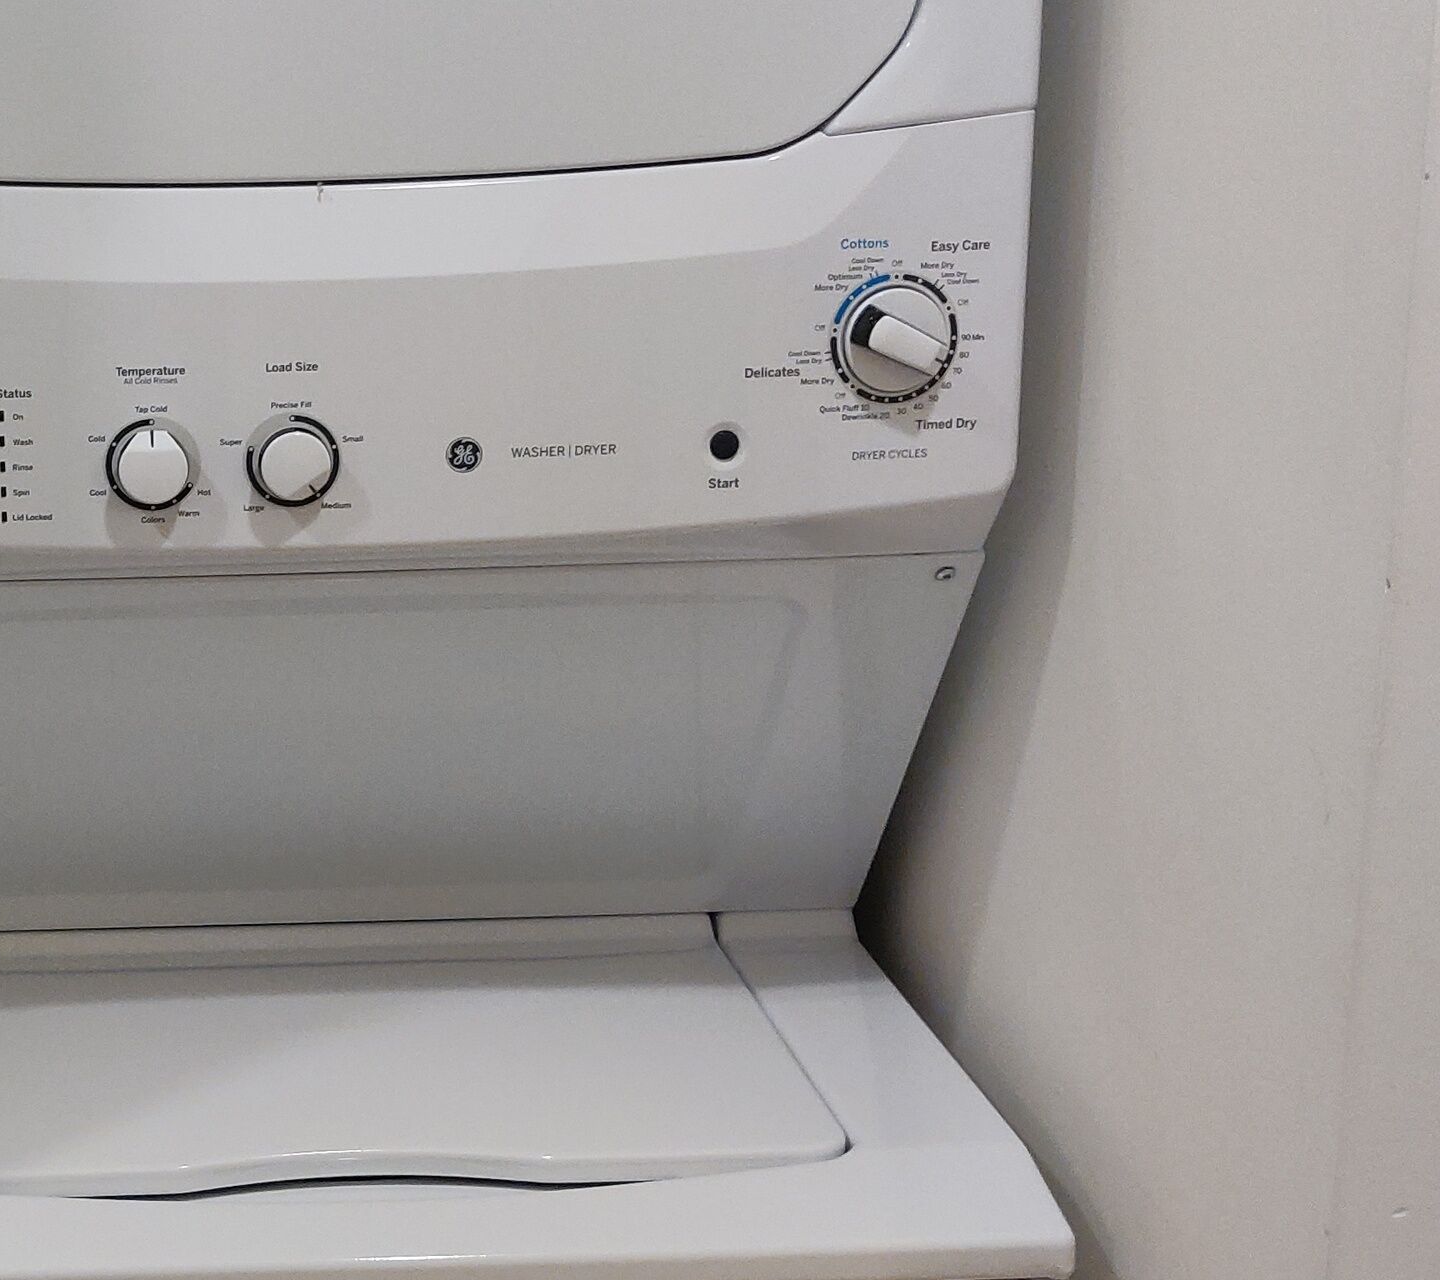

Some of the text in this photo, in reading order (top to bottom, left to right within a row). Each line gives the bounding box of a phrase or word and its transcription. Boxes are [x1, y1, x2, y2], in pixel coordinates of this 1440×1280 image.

[841, 239, 889, 249] Cottons
[931, 240, 991, 253] Easy Care
[265, 362, 318, 372] Load Size
[115, 365, 186, 379] Temperature
[744, 368, 800, 378] Delicates
[134, 405, 168, 414] Tap Cold
[12, 413, 24, 421] On
[916, 418, 977, 430] Timed Dry
[12, 438, 33, 446] Wash
[88, 435, 106, 443] Cold
[219, 438, 243, 447] Super
[342, 435, 363, 443] Small
[511, 445, 566, 458] WASHER
[574, 444, 616, 456] DRYER
[852, 448, 928, 460] DRYER CYCLES
[708, 478, 739, 489] Start
[12, 489, 30, 497] Spin
[89, 489, 107, 497] Cool
[243, 504, 264, 512] Large
[178, 509, 200, 517] Warm
